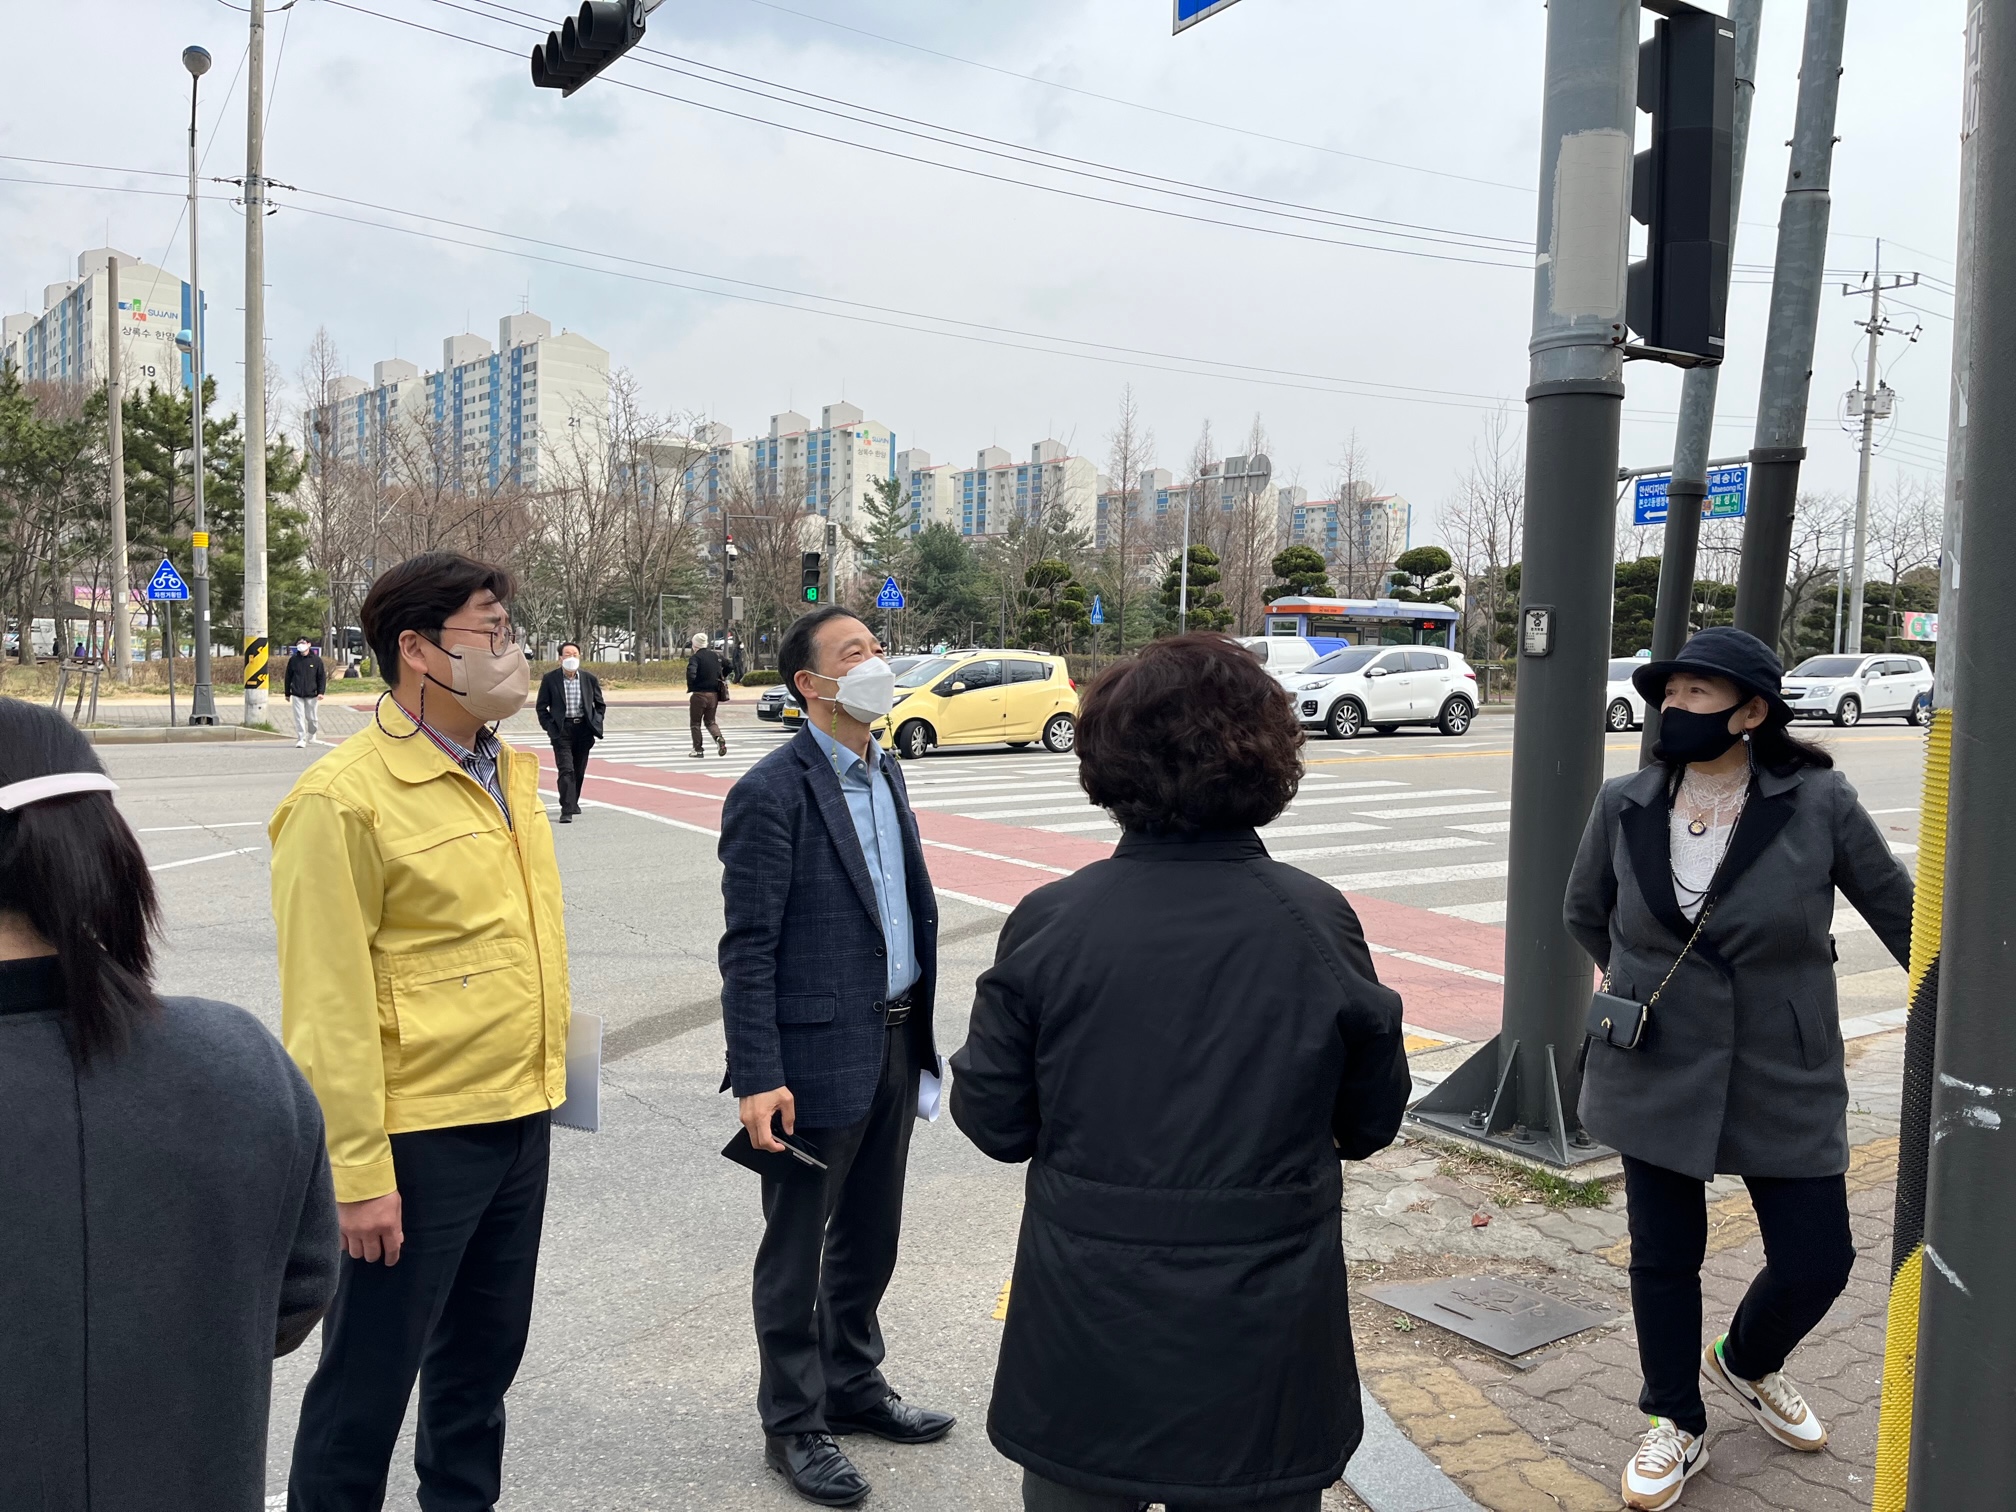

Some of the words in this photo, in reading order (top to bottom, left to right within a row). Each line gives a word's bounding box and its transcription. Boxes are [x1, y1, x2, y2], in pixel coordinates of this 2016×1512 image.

[148, 309, 178, 319] SUJAIN
[122, 326, 151, 337] 상록수
[155, 331, 175, 341] 한양
[140, 365, 155, 376] 19
[568, 416, 581, 428] 21
[1736, 483, 1744, 491] IC
[1715, 494, 1738, 504] 화성시
[154, 591, 182, 599] 자전거횡단
[806, 587, 818, 601] 18
